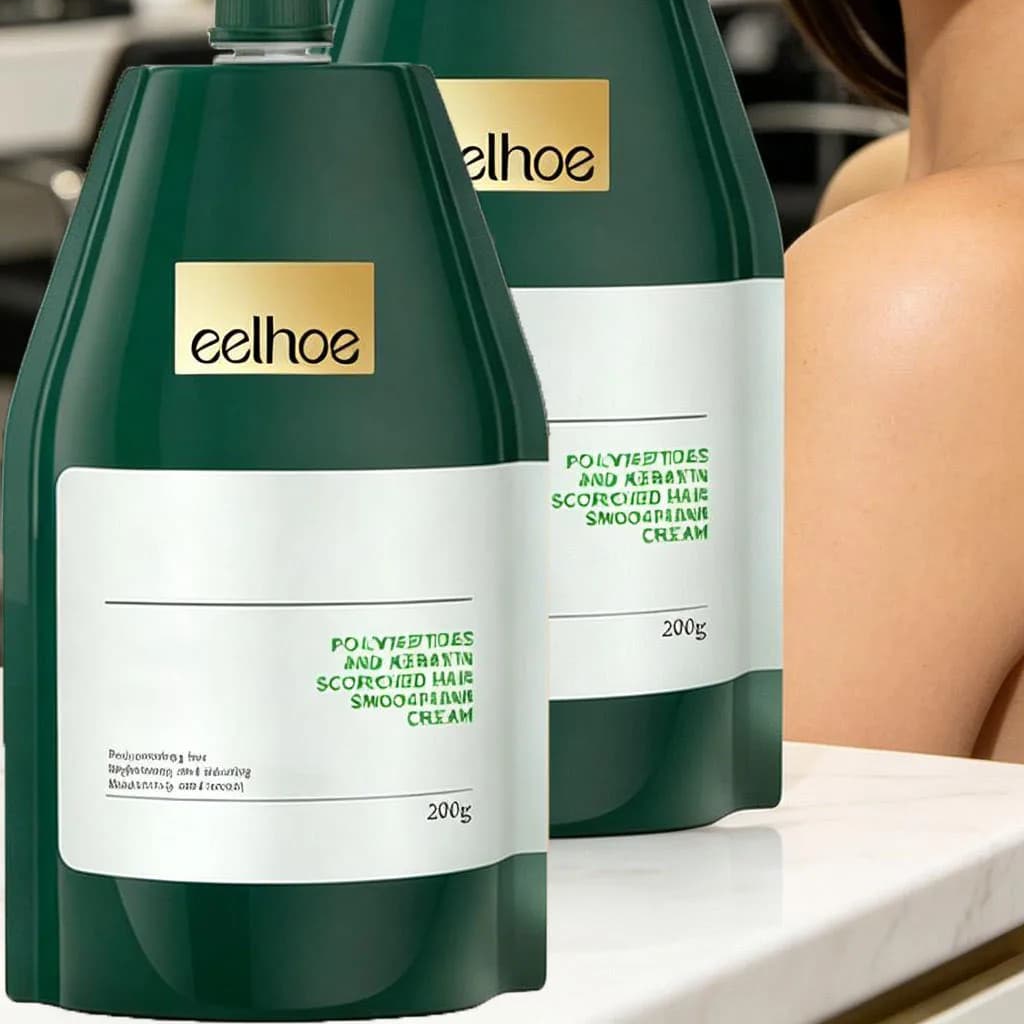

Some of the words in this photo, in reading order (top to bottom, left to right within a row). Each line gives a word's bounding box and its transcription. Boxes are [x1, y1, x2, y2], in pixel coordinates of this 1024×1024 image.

[462, 132, 594, 182] elhoe
[192, 316, 359, 364] eelhoe
[579, 472, 618, 487] AND
[642, 524, 708, 544] CREAM
[662, 618, 707, 641] 200g
[344, 655, 383, 670] AND
[407, 707, 473, 727] CREAM
[427, 801, 472, 824] 200g
